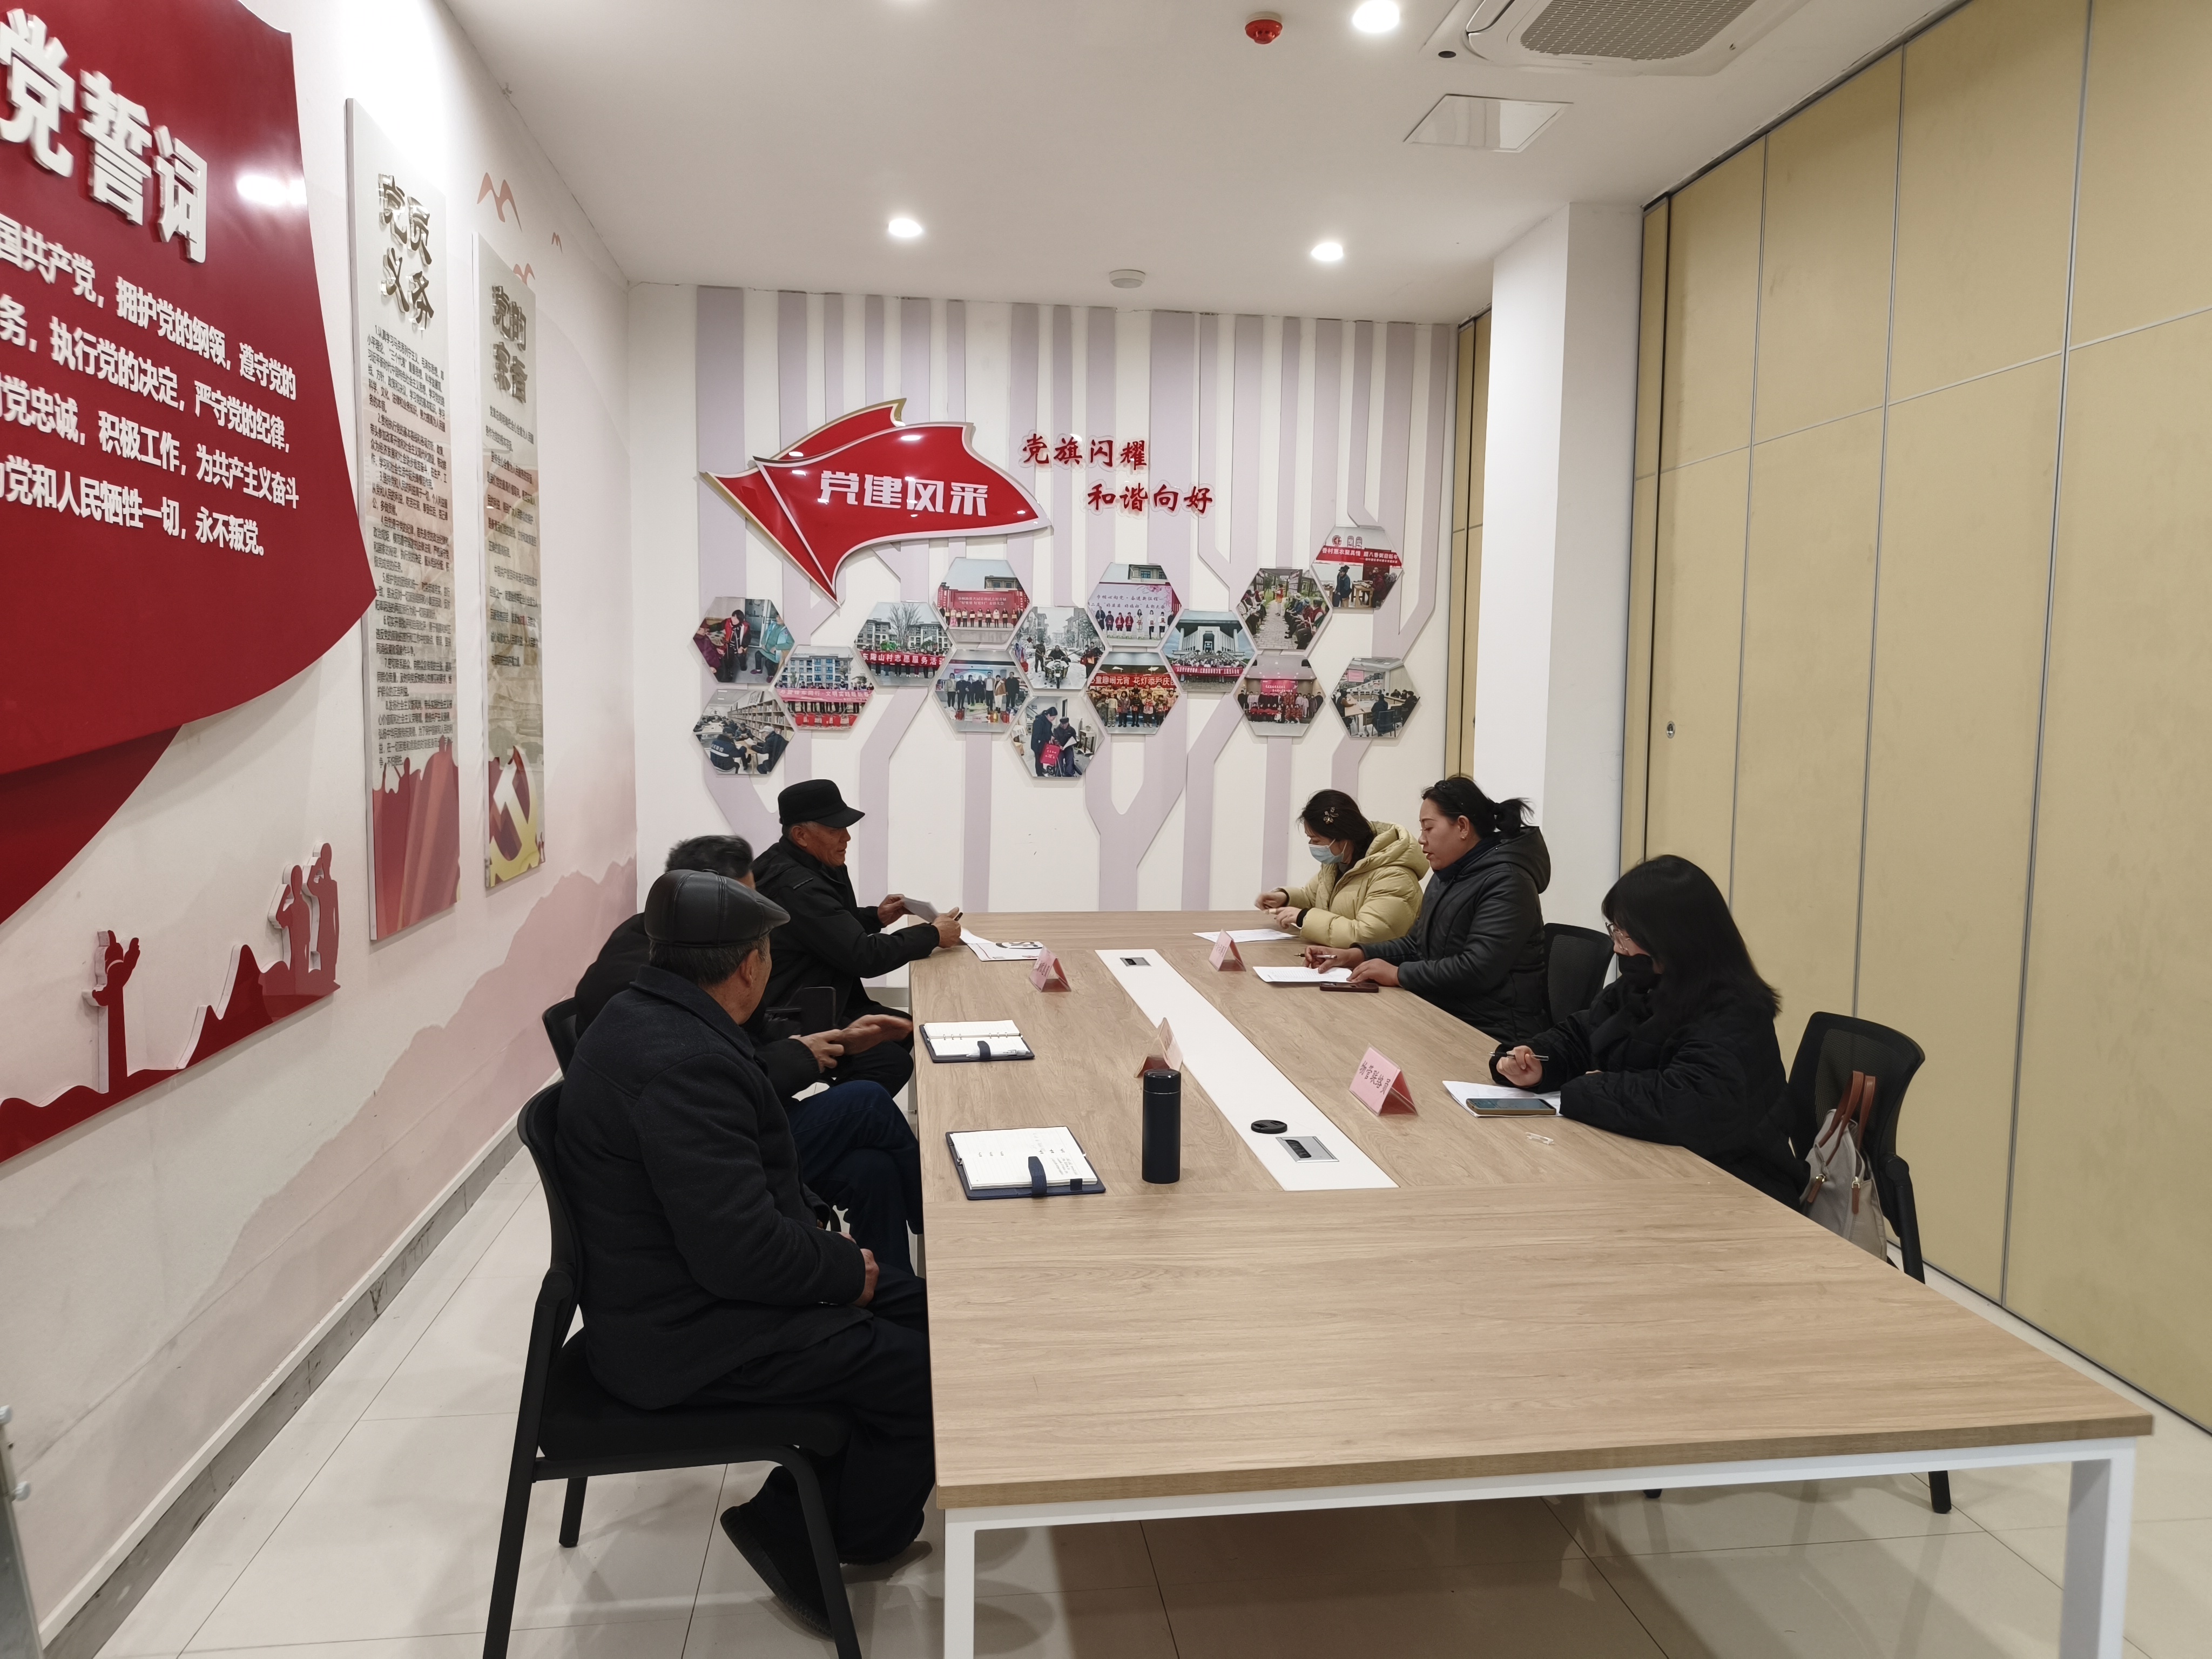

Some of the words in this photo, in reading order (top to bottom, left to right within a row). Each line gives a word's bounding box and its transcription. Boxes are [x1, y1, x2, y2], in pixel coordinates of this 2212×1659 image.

[0, 8, 207, 263] 党誓词
[378, 173, 432, 266] 党员
[380, 247, 434, 331] 义务
[491, 285, 527, 351] 党的
[0, 373, 299, 509] 党忠诚，积极工作，为共产主义奋斗
[1022, 433, 1147, 471] 党旗闪耀
[0, 455, 264, 555] 党和人民牺牲一切，永不叛党。
[817, 470, 988, 516] 党建风采
[1087, 482, 1213, 515] 和谐向好
